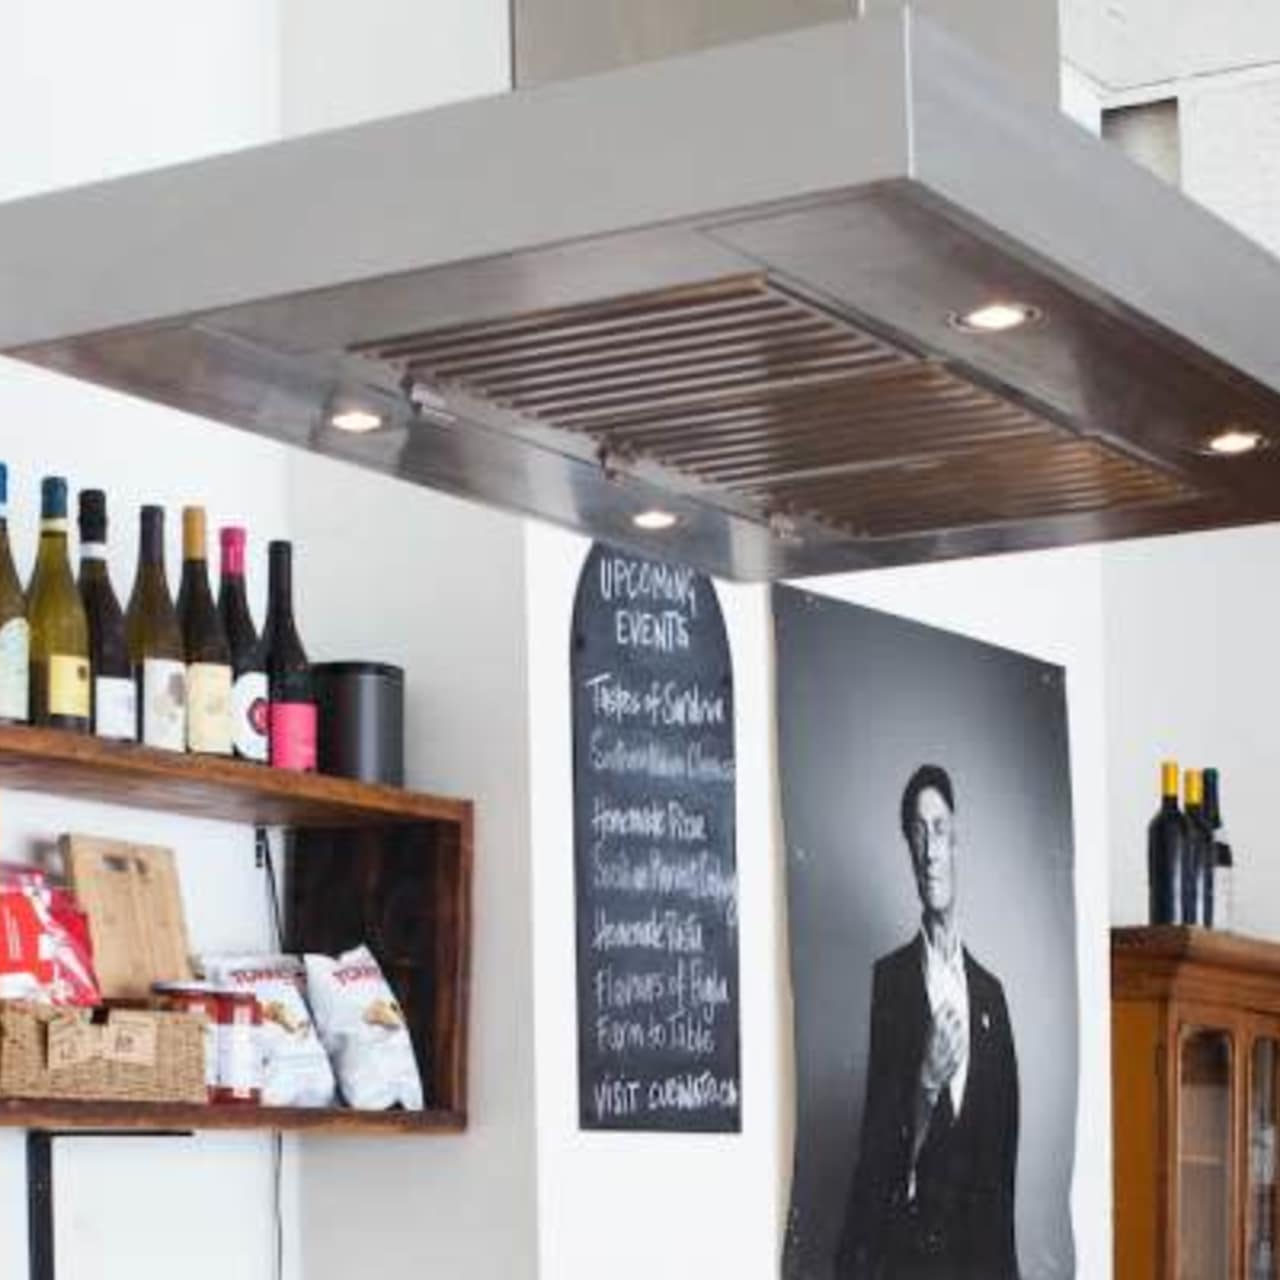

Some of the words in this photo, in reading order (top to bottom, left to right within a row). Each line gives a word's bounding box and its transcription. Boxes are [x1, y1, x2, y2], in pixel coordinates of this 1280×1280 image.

[599, 556, 698, 620] UPCOMING
[615, 608, 690, 653] EVENTS
[595, 1013, 645, 1052] Farm
[667, 1008, 715, 1054] Table
